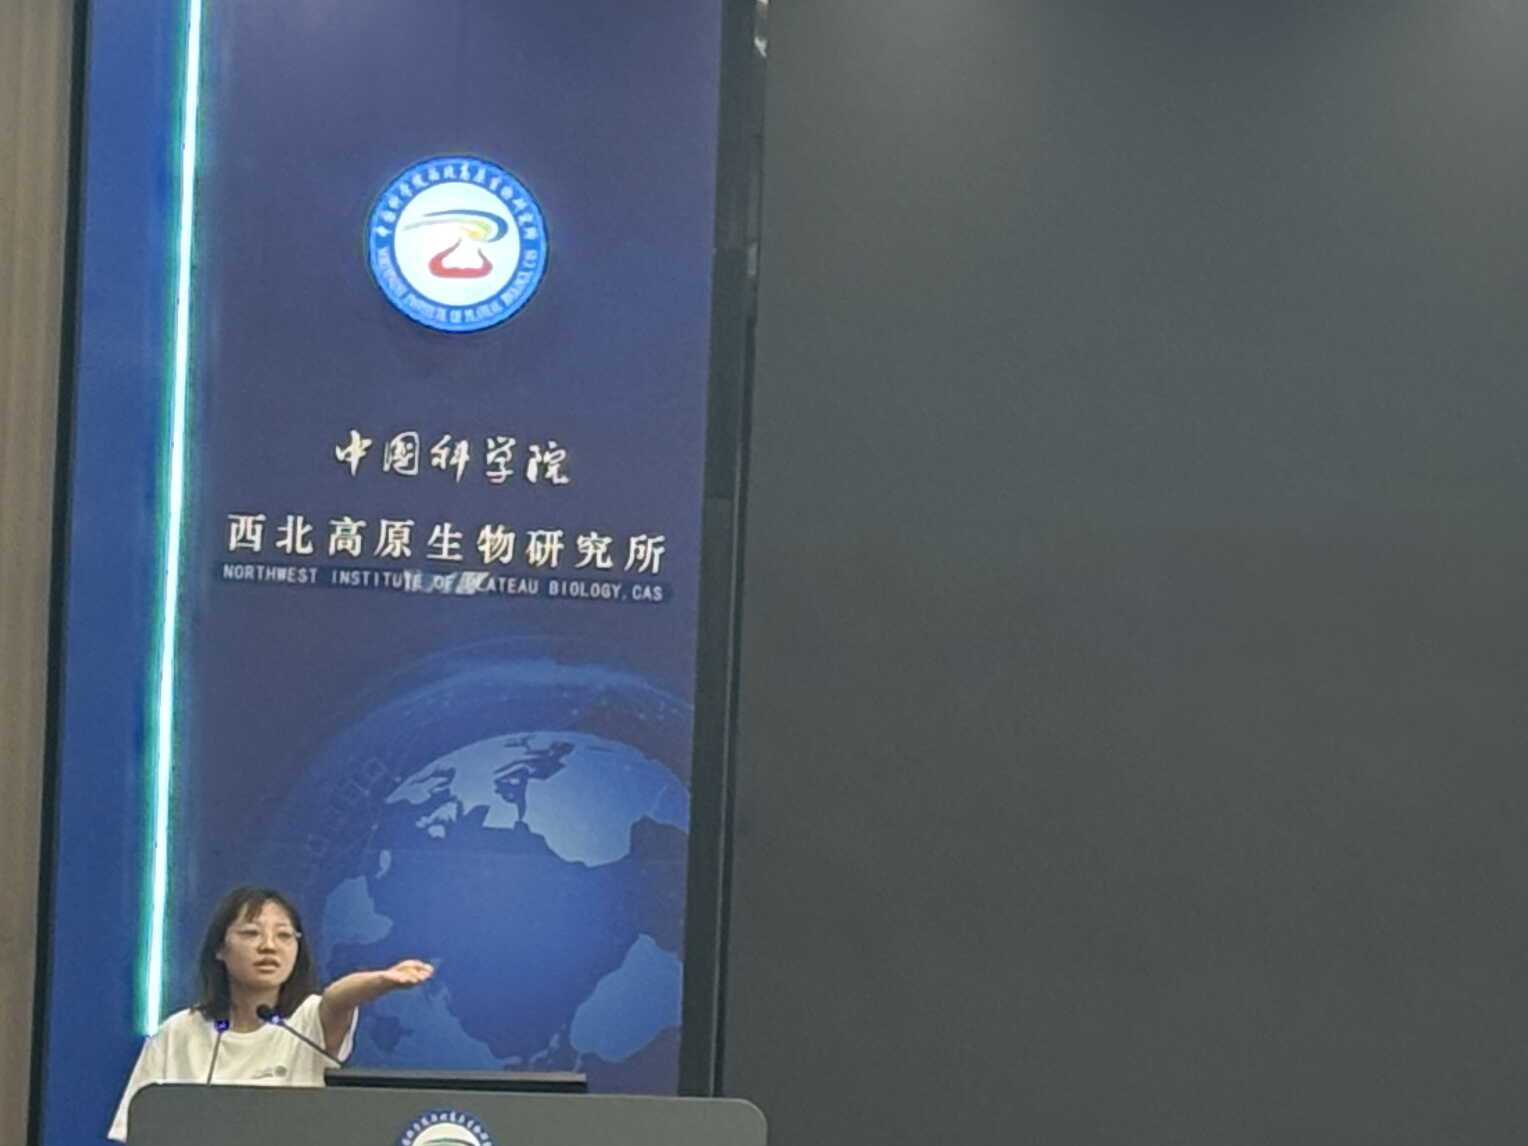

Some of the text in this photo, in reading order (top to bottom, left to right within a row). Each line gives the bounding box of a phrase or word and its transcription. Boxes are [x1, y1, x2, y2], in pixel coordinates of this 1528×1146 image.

[335, 428, 571, 485] 中国科学院
[226, 513, 666, 575] 西北高原生物研究所
[222, 563, 318, 584] NORTHWEST
